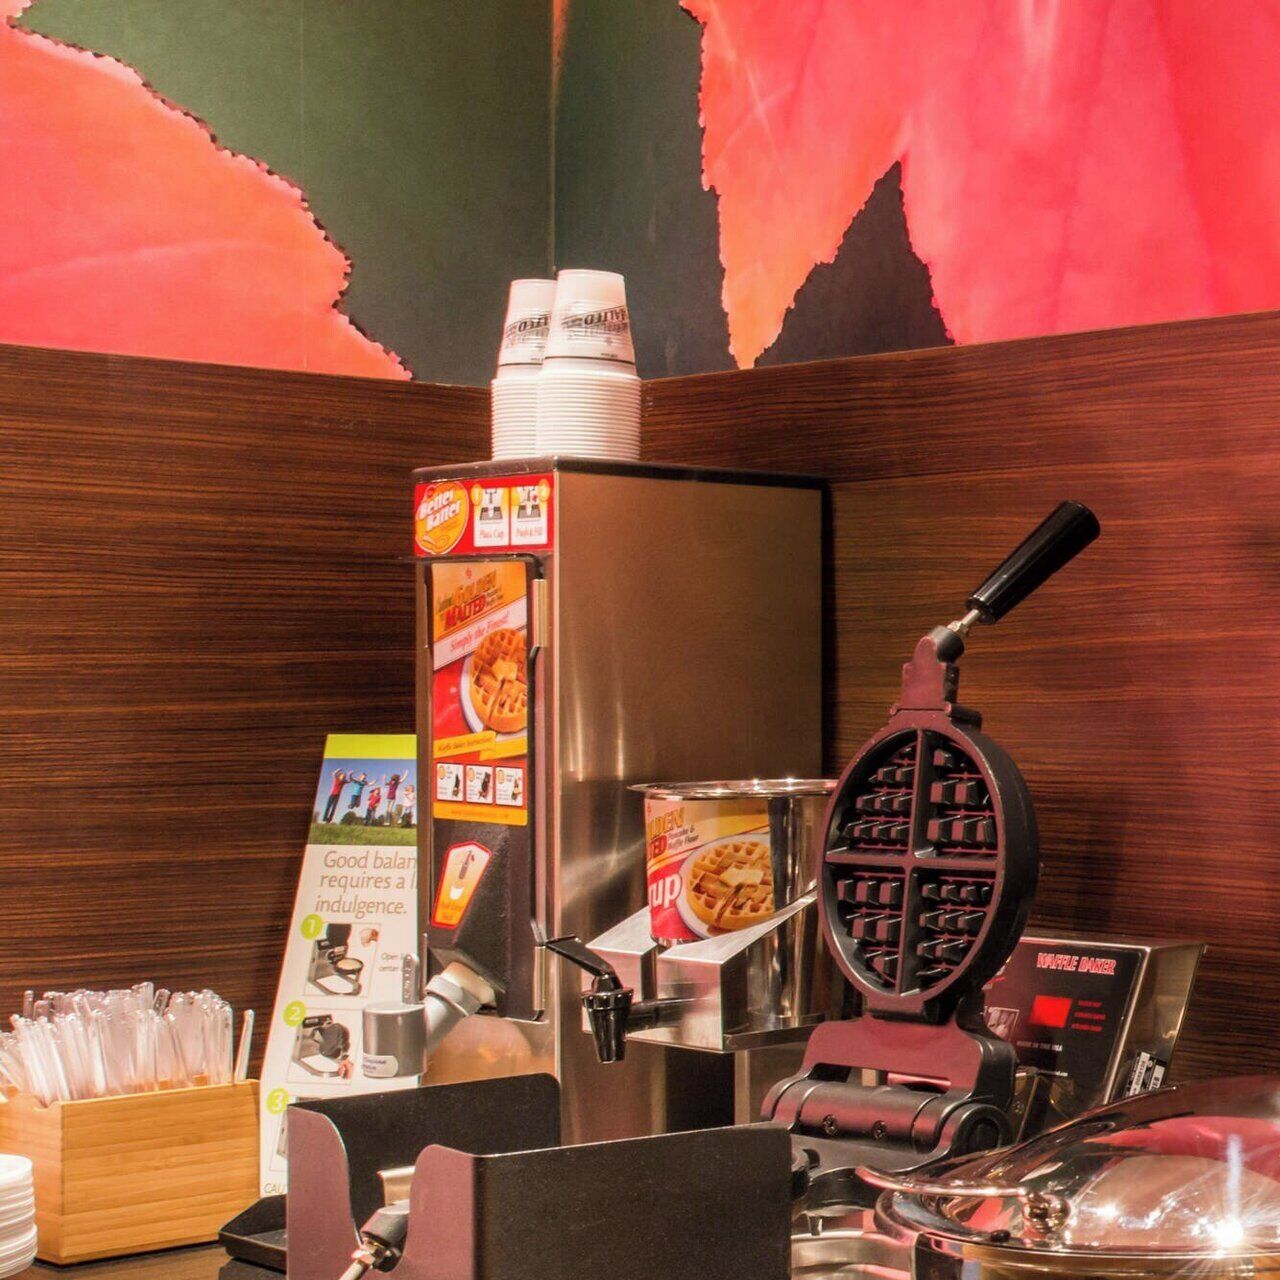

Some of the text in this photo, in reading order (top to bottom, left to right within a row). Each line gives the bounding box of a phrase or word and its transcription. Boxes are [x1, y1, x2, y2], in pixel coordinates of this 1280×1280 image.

[444, 594, 485, 632] MALTED
[323, 850, 370, 869] Good
[320, 870, 392, 894] requires
[396, 876, 406, 889] a
[315, 894, 407, 920] indulgence.
